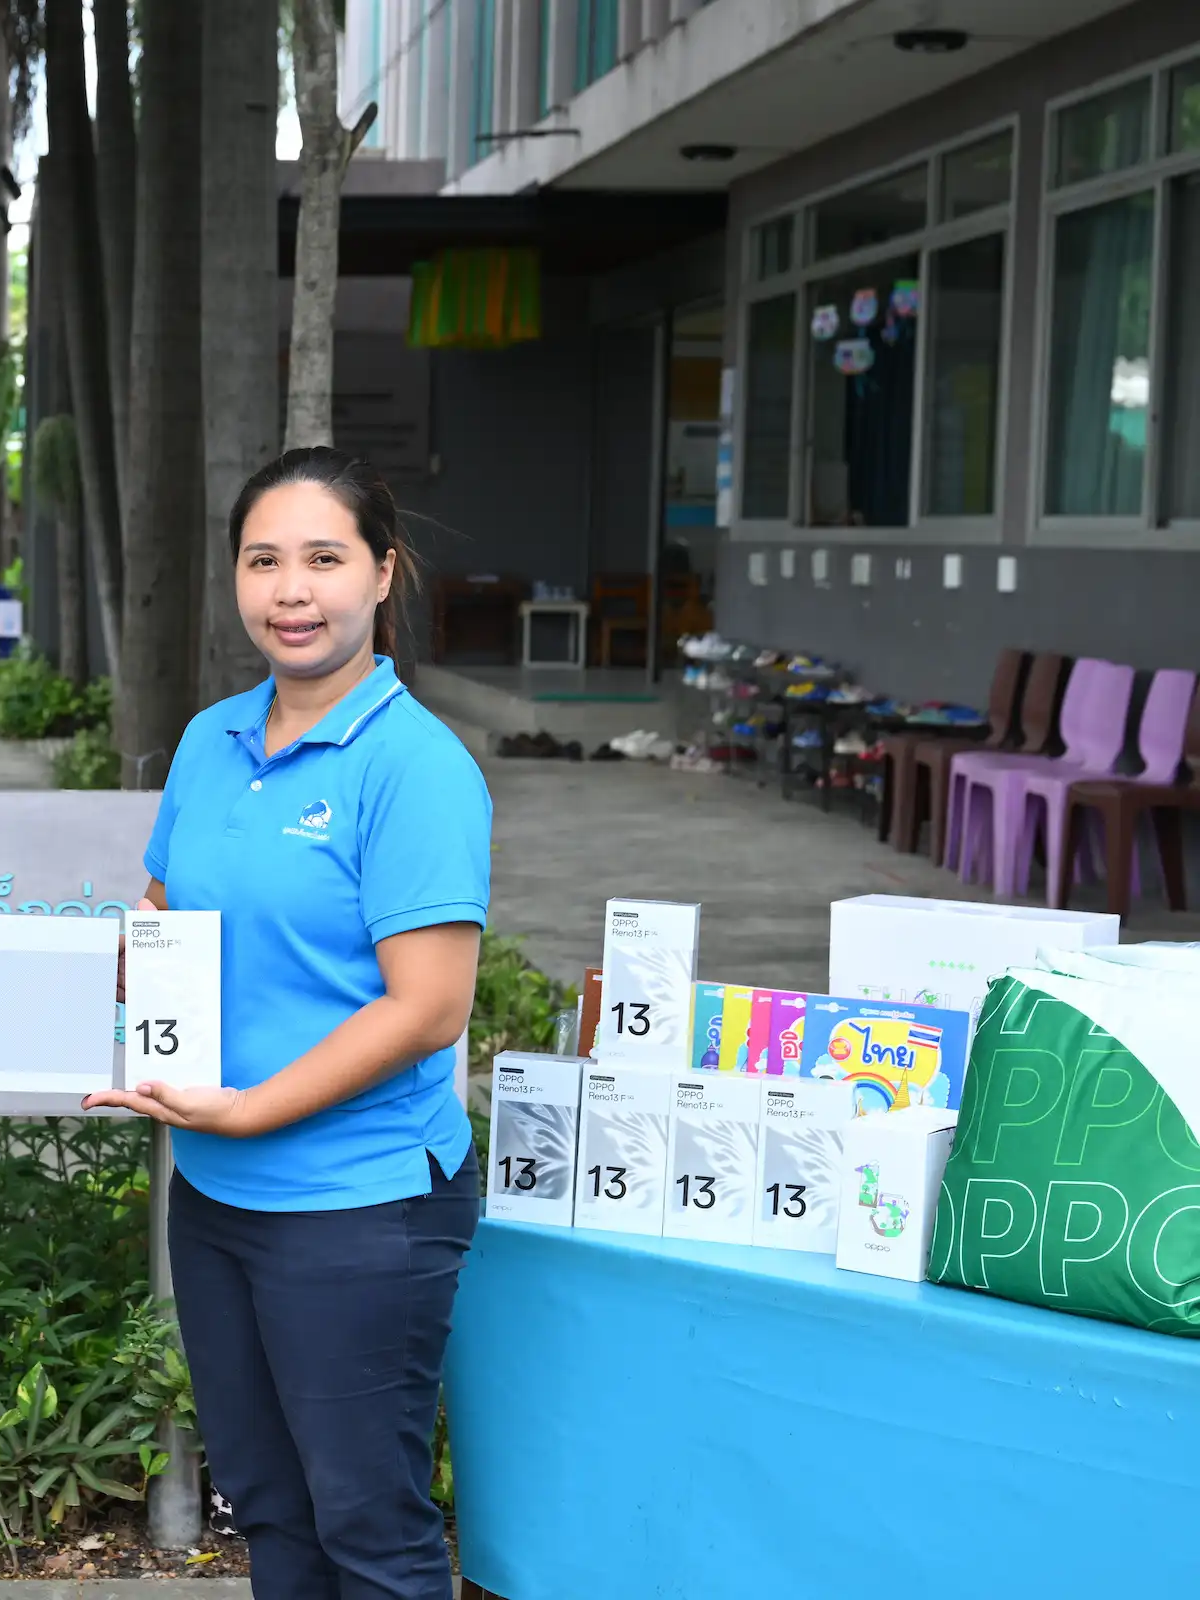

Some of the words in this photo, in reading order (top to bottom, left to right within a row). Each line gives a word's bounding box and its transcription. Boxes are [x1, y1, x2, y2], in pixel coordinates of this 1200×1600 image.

[612, 918, 639, 928] OPPO
[132, 929, 160, 938] OPPO
[612, 928, 643, 938] Reno13
[132, 939, 165, 949] Reno13
[611, 1002, 650, 1036] 13
[135, 1019, 179, 1055] 13
[781, 1032, 803, 1058] อิ
[849, 1022, 914, 1068] ไทย
[498, 1074, 524, 1084] OPPO
[498, 1083, 528, 1093] Reno13
[589, 1081, 615, 1091] OPPO
[589, 1091, 619, 1101] Reno13
[620, 1094, 626, 1102] F
[677, 1090, 703, 1100] OPPO
[677, 1099, 708, 1110] Reno13
[709, 1102, 715, 1110] F
[767, 1098, 794, 1108] OPPO
[767, 1107, 798, 1118] Reno13
[498, 1156, 537, 1191] 13
[588, 1165, 627, 1200] 13
[676, 1174, 716, 1209] 13
[766, 1183, 807, 1218] 13
[864, 1242, 890, 1253] oppo
